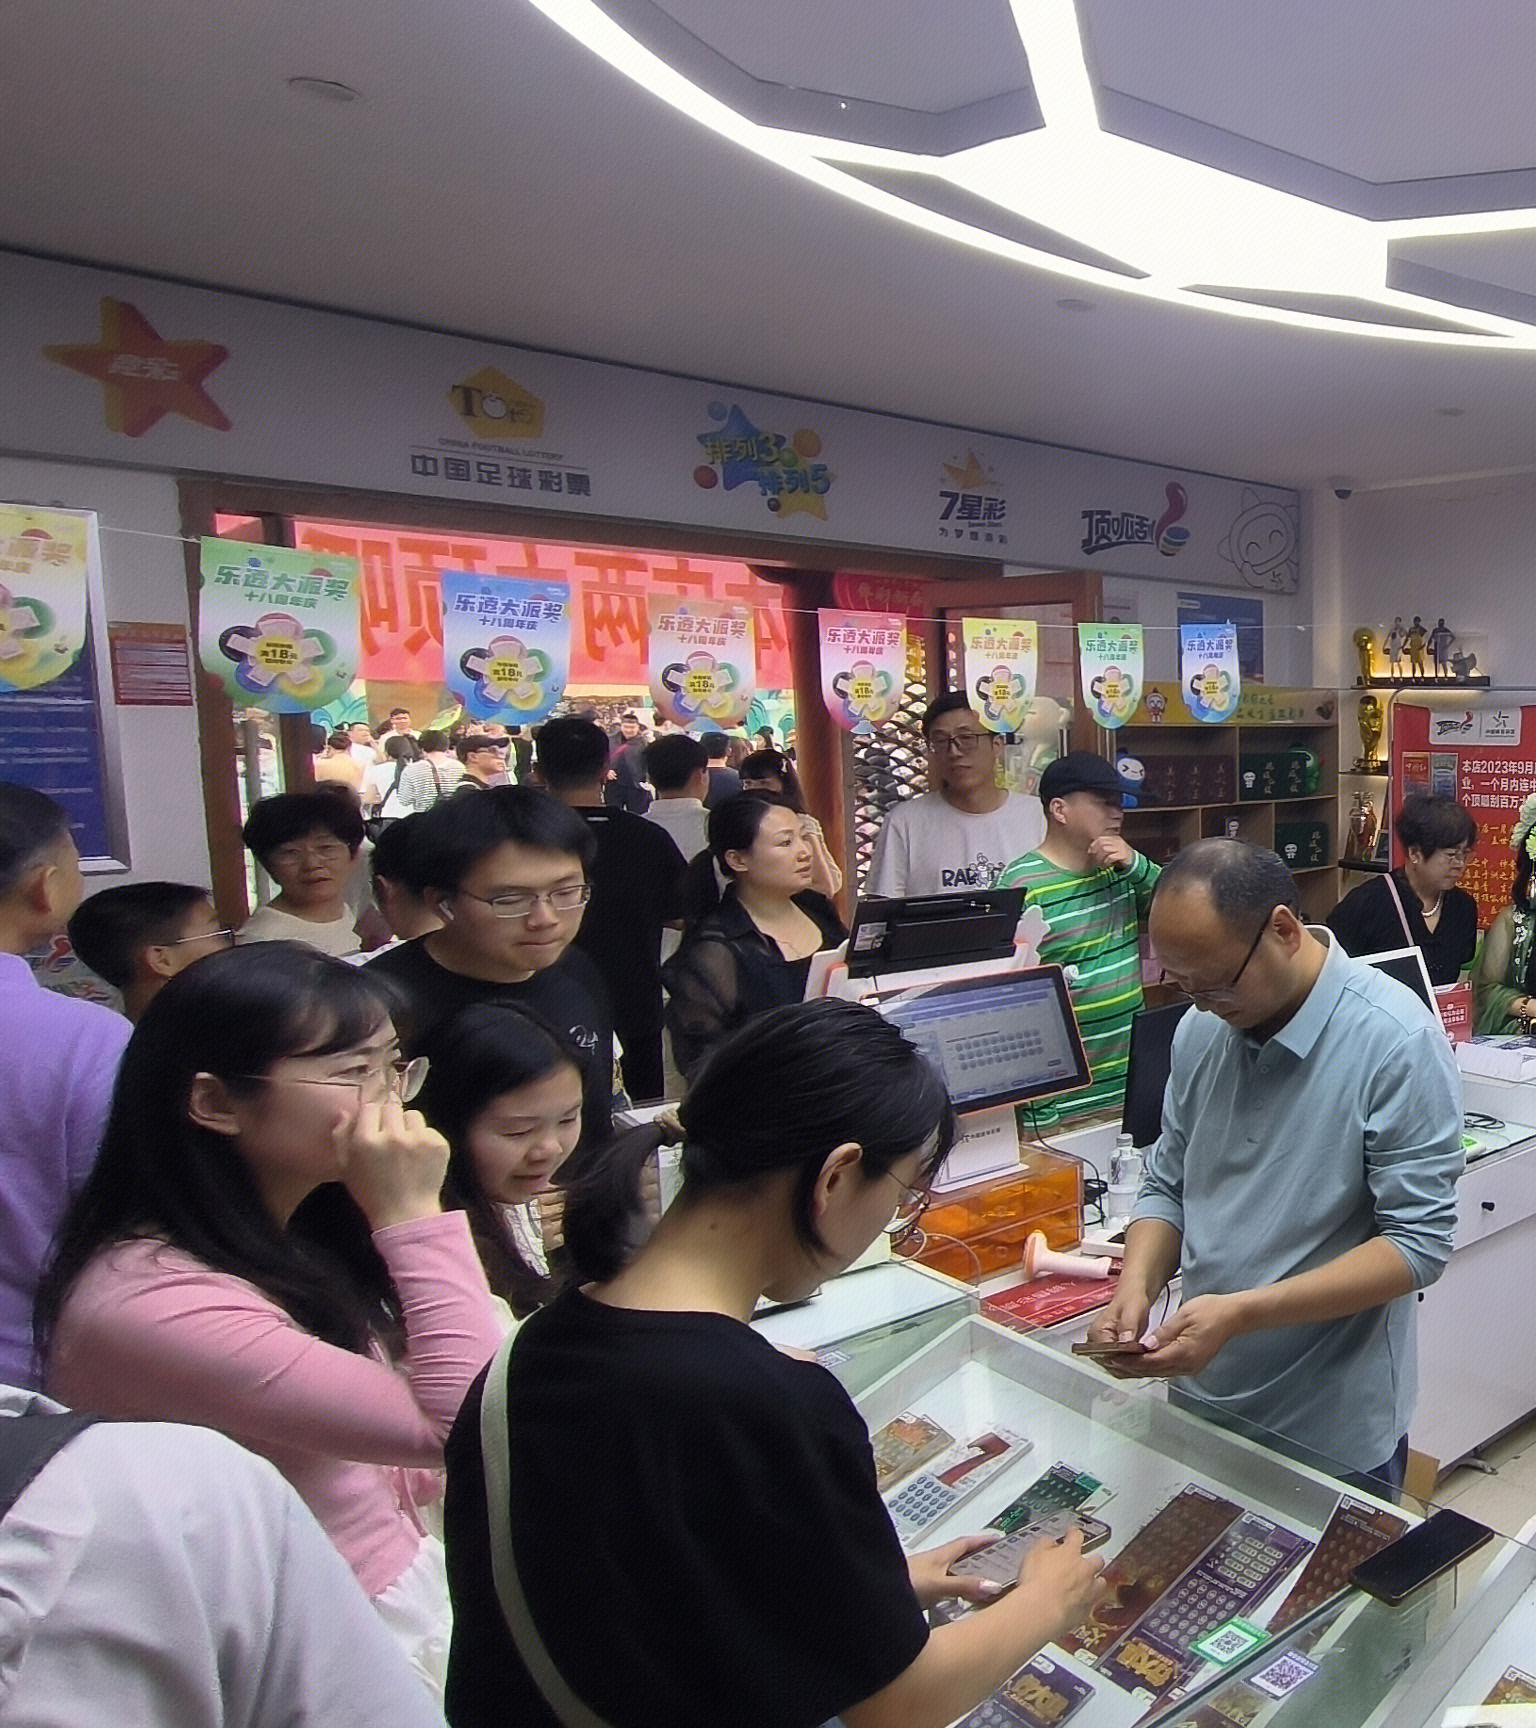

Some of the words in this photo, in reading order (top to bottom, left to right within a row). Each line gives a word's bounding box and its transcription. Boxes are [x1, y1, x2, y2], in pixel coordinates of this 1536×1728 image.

[704, 433, 781, 465] 排列3
[411, 454, 592, 497] 中国足球彩票
[939, 490, 1007, 520] 7星彩
[213, 564, 350, 601] 乐透大派奖
[244, 590, 318, 609] 十八周年庆
[454, 593, 564, 624] 乐透大派奖
[478, 615, 539, 631] 十八周年庆
[658, 614, 747, 639] 乐透大派奖
[677, 633, 727, 646] 十八周年庆
[827, 627, 901, 648] 乐透大派奖
